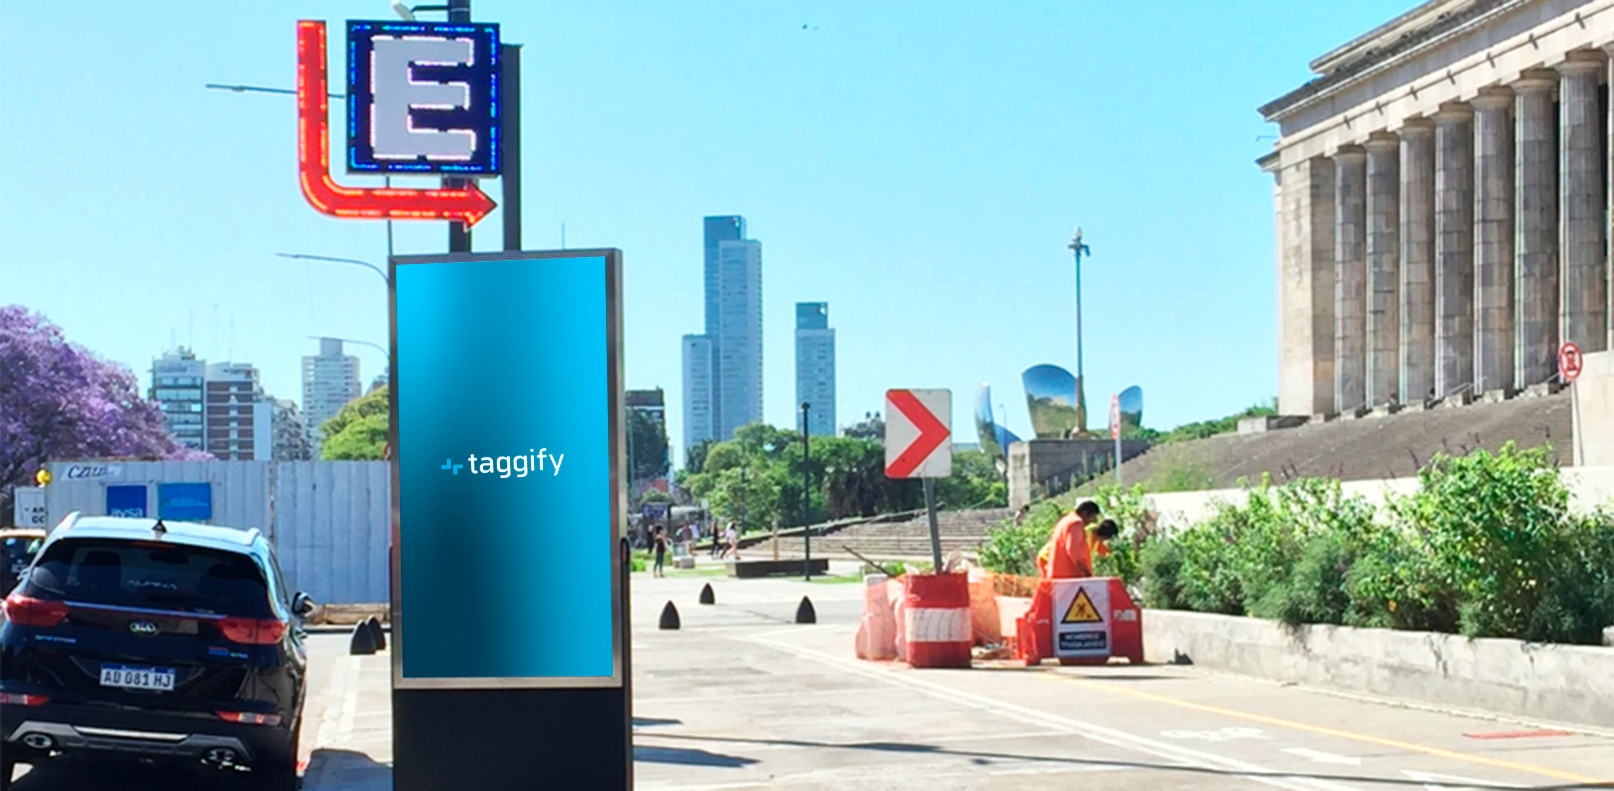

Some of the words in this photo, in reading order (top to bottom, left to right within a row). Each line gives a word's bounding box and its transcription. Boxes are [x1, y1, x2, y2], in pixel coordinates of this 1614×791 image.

[369, 35, 476, 161] E
[468, 447, 565, 478] taggify
[124, 671, 149, 687] 081
